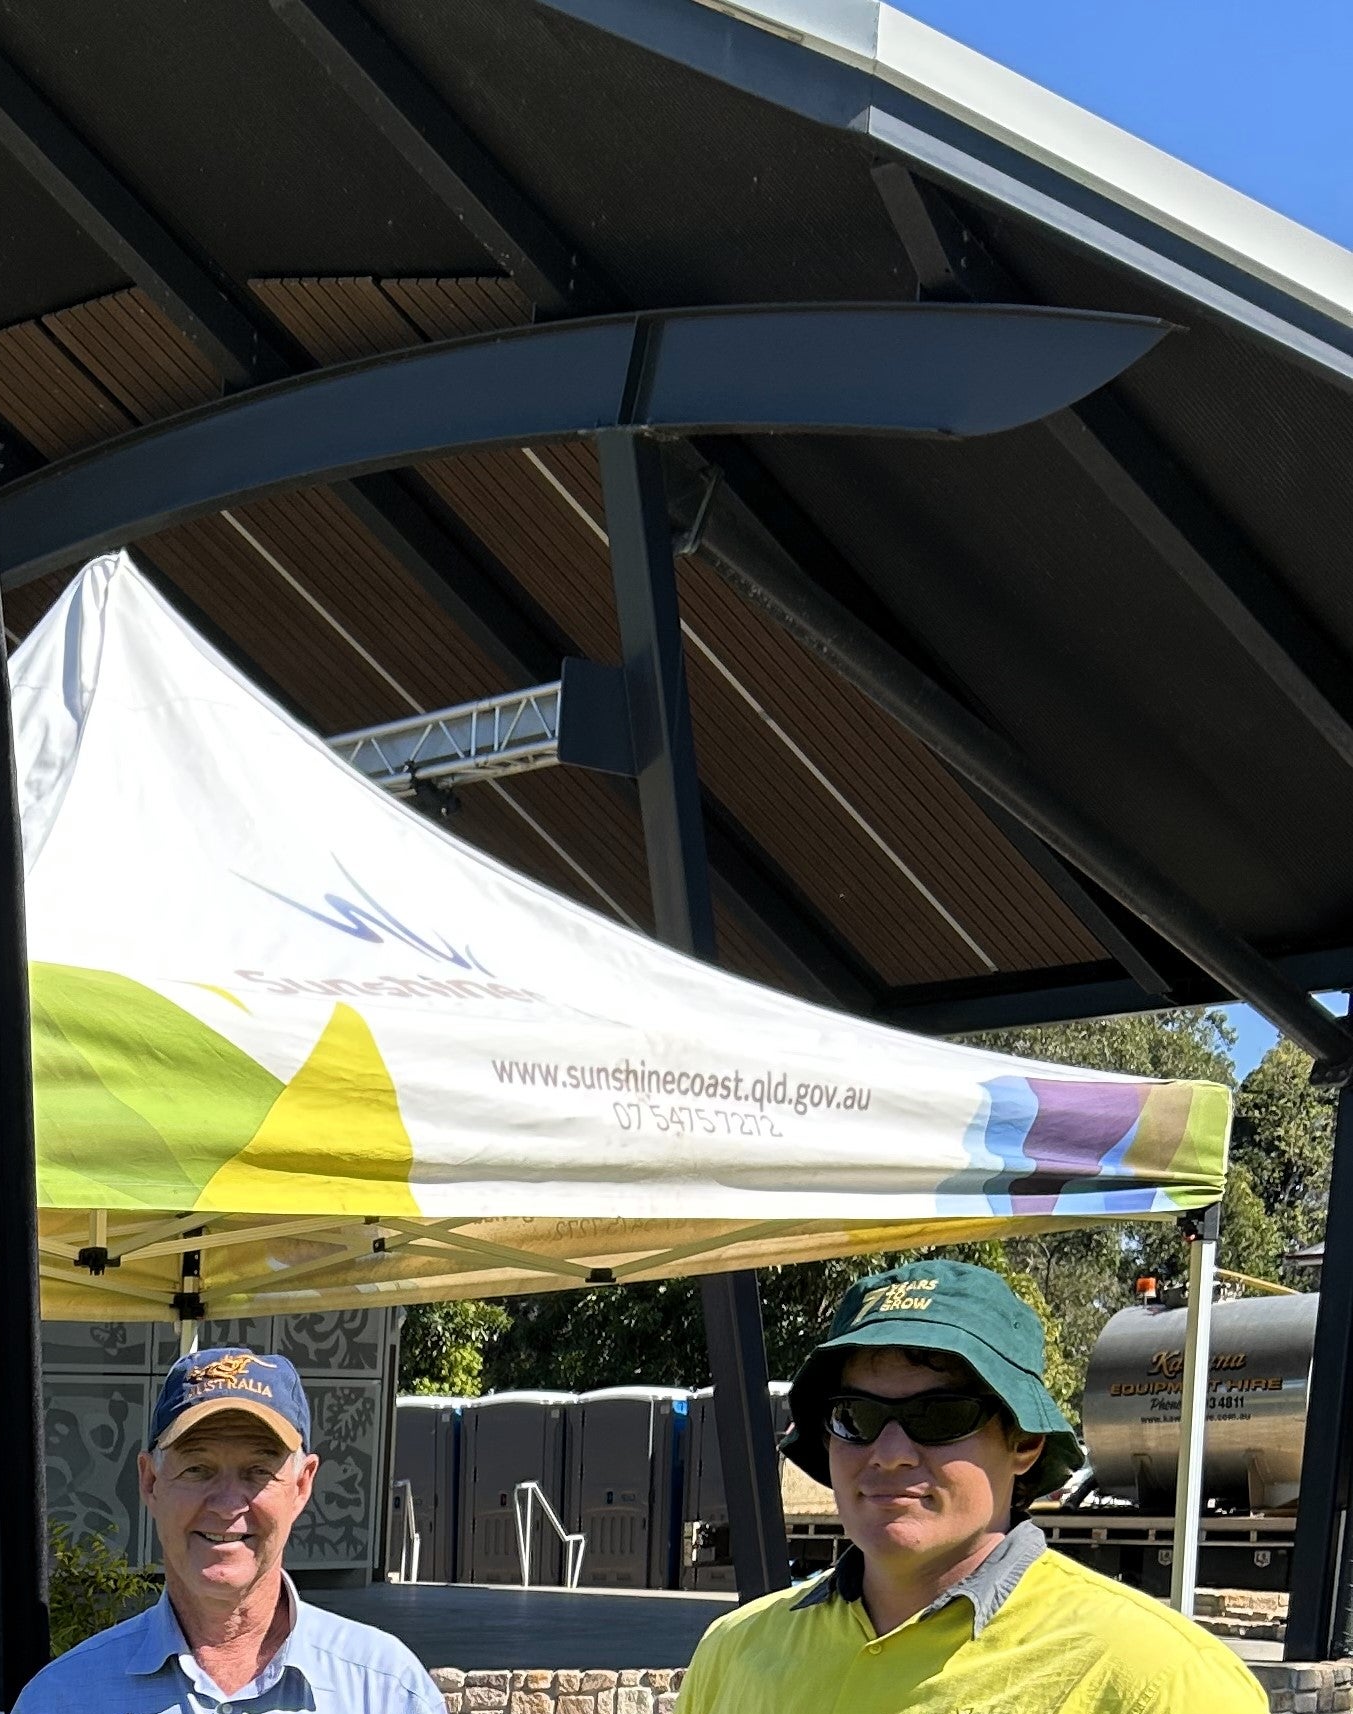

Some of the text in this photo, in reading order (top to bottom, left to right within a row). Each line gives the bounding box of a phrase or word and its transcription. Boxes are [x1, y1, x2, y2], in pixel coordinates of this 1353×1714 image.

[491, 1058, 872, 1115] www.sunshinecoast.qld.gov.au
[612, 1102, 783, 1138] 07 5475 7272
[851, 1286, 890, 1326] 7
[885, 1288, 906, 1300] TO
[1148, 1350, 1247, 1379] Kana
[1110, 1377, 1283, 1396] EQUIPMT HIRE
